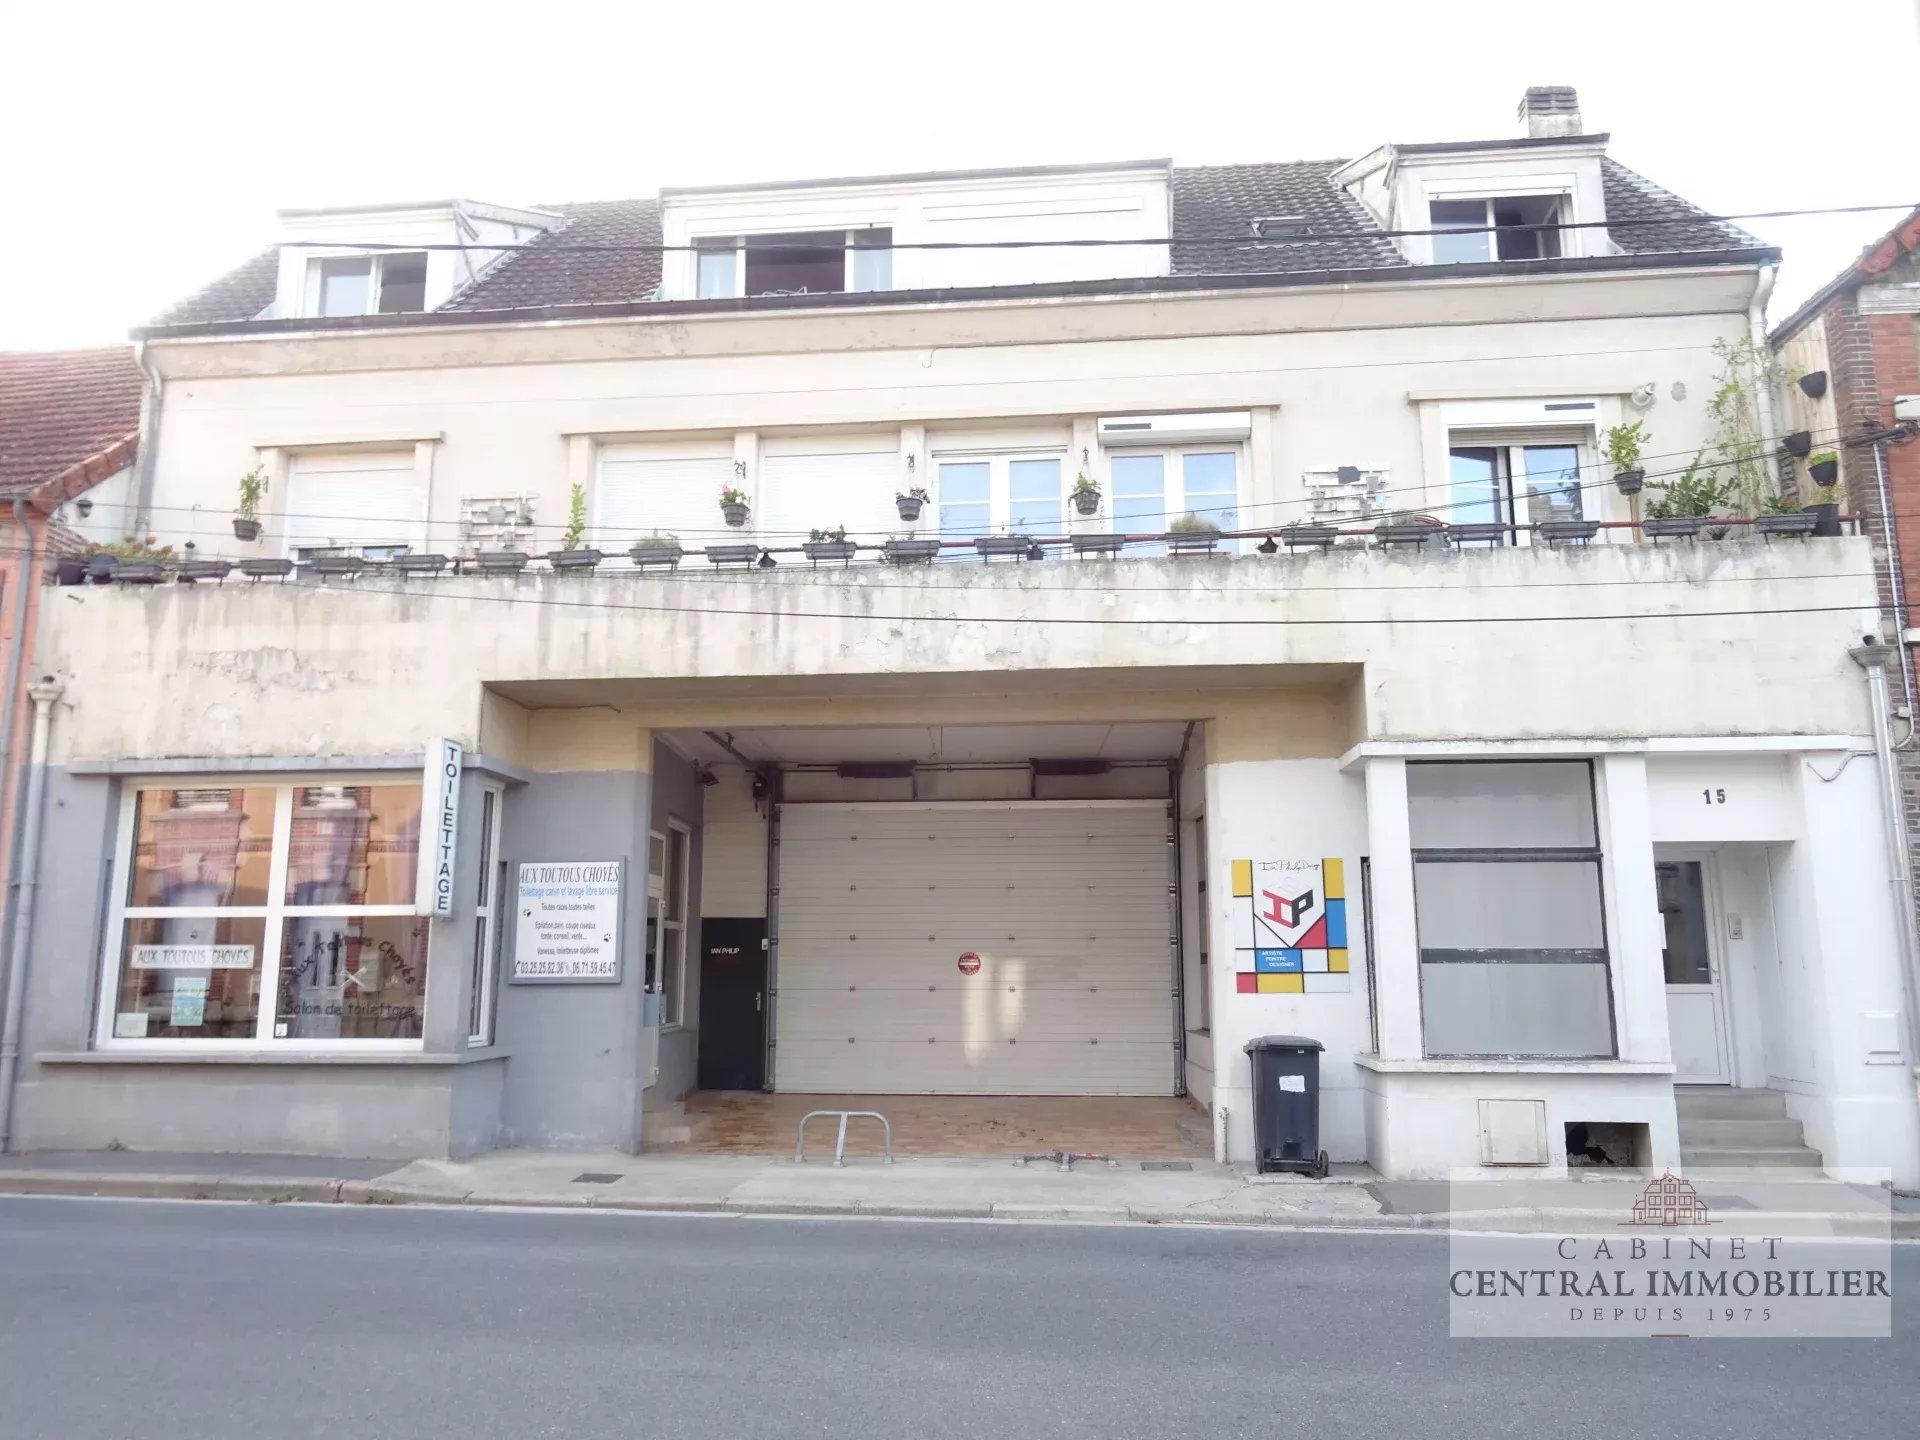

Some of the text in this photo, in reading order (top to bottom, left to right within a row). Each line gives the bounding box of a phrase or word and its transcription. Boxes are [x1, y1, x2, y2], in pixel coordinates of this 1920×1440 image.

[1702, 789, 1726, 804] 15
[438, 747, 457, 910] TOILETTAGE
[520, 863, 620, 884] AUX TOUTOUS CHOYÉS
[136, 949, 159, 963] AUX
[163, 949, 206, 963] TOUTOUS
[721, 947, 740, 955] PHILIP
[285, 1000, 418, 1021] Salon de toilettage
